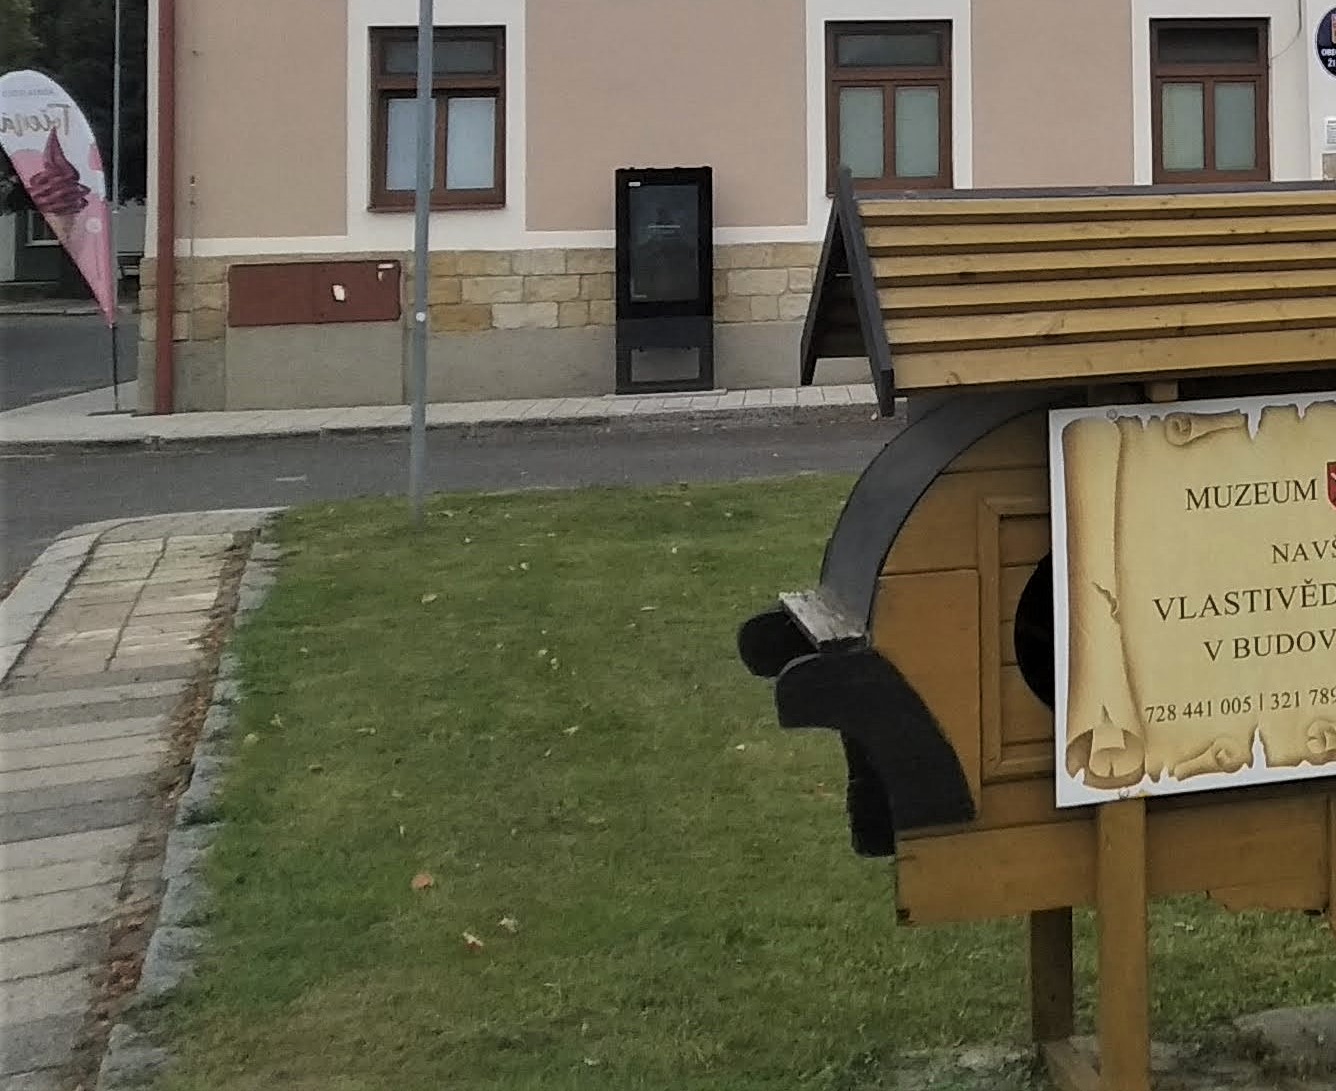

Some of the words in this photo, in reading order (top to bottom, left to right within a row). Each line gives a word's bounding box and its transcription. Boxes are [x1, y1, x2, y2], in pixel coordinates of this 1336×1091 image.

[1185, 478, 1318, 511] MUZEUM
[1203, 640, 1223, 661] V
[1145, 705, 1177, 723] 728
[1182, 701, 1212, 719] 441
[1220, 696, 1251, 715] 005
[1270, 691, 1301, 710] 321
